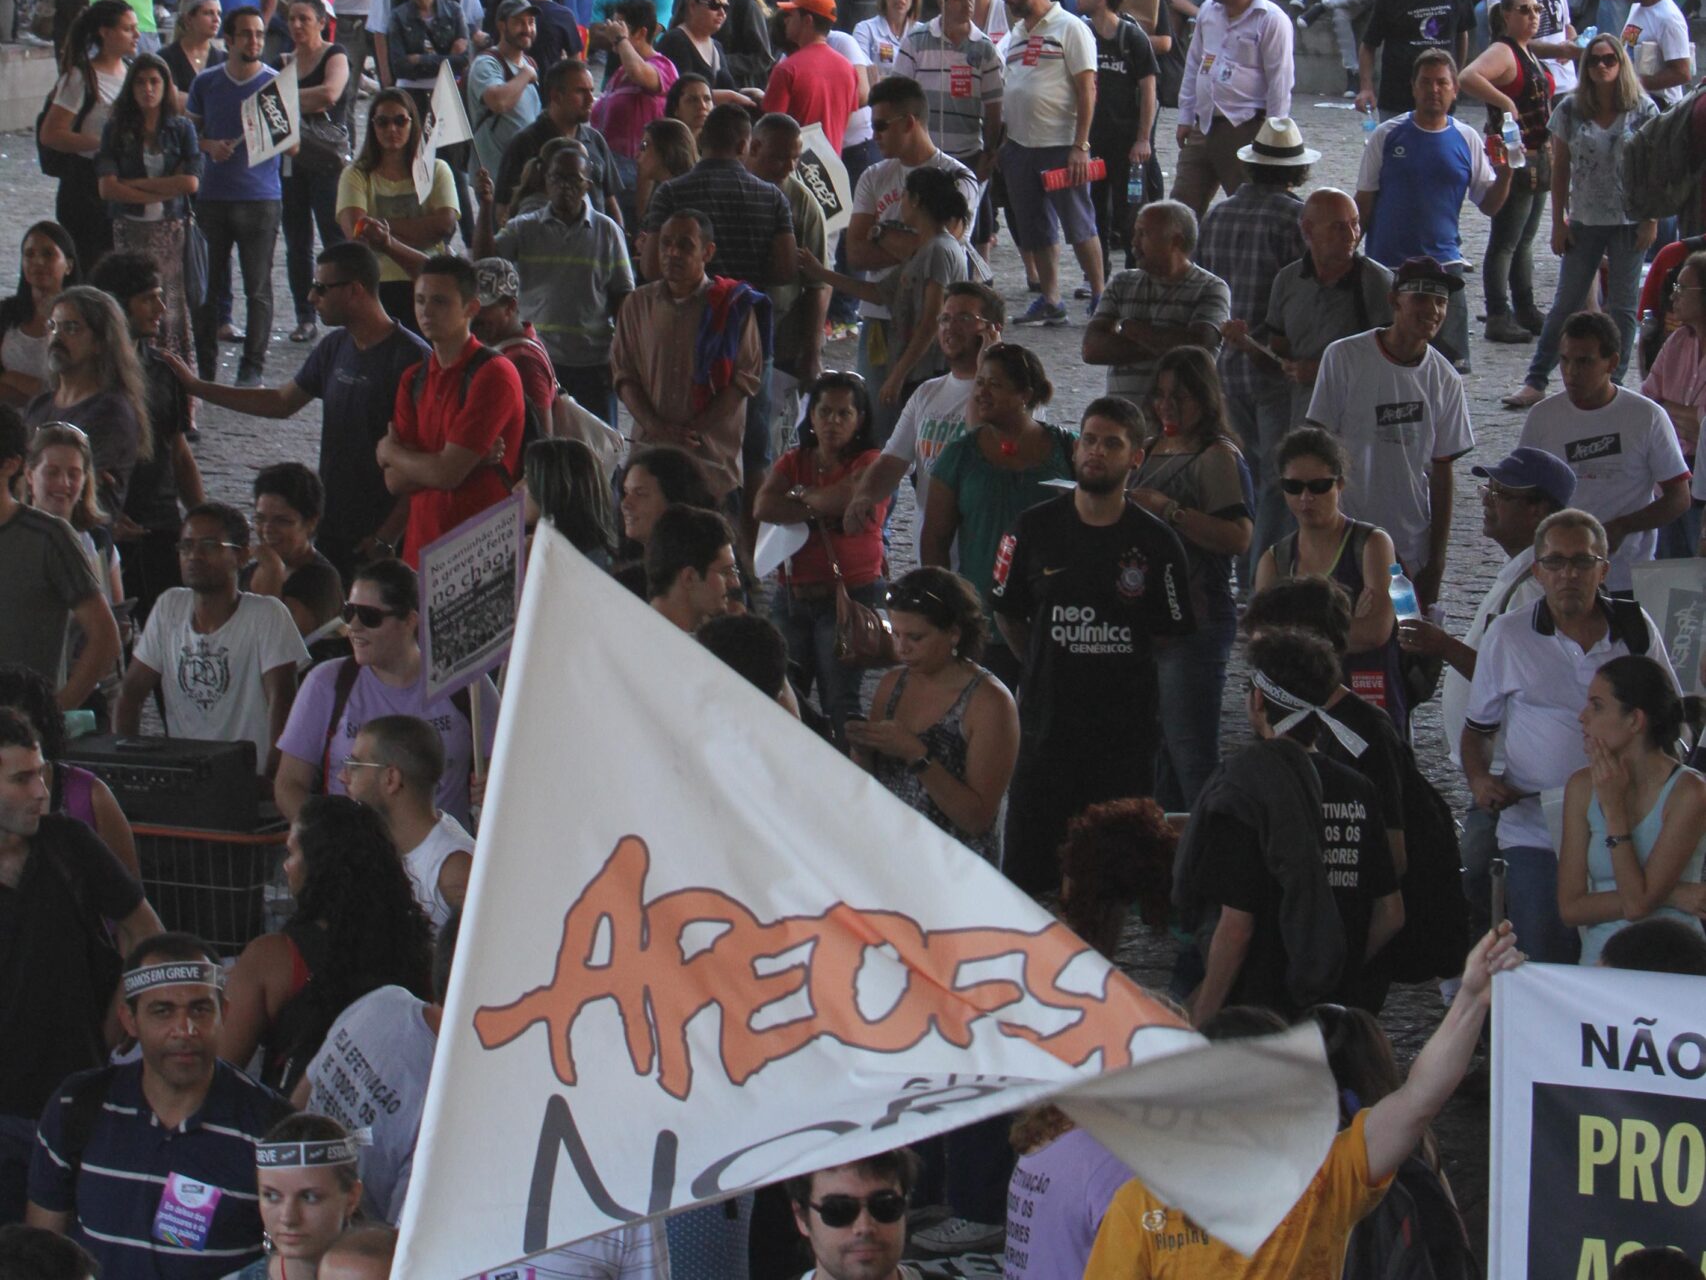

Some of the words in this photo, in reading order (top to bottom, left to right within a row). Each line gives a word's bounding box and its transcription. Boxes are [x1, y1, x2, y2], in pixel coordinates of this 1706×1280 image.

[433, 584, 456, 607] no
[462, 546, 511, 588] chão!
[441, 555, 475, 585] greve
[1052, 605, 1096, 622] neo
[1069, 642, 1133, 654] GENÉRICOS
[1352, 680, 1384, 688] GREVE
[1345, 825, 1361, 842] OS
[151, 968, 165, 981] EM
[166, 967, 200, 980] GREVE
[1580, 1017, 1706, 1080] NÃO
[359, 1102, 376, 1125] OS
[1578, 1114, 1706, 1207] PRO
[1021, 1199, 1034, 1218] OS
